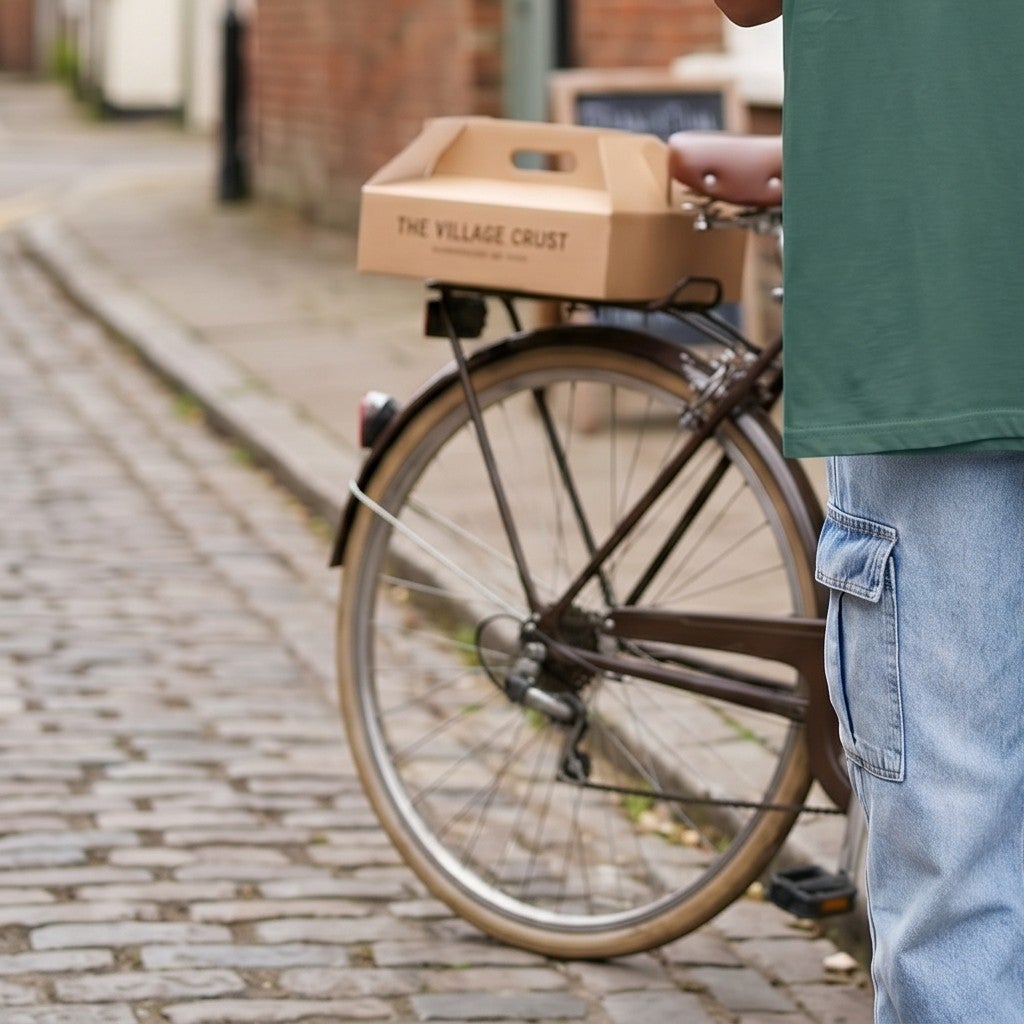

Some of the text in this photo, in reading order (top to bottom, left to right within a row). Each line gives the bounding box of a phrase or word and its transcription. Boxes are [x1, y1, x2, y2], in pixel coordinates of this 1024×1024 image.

[398, 215, 569, 251] THE VILLAGE CRUST
